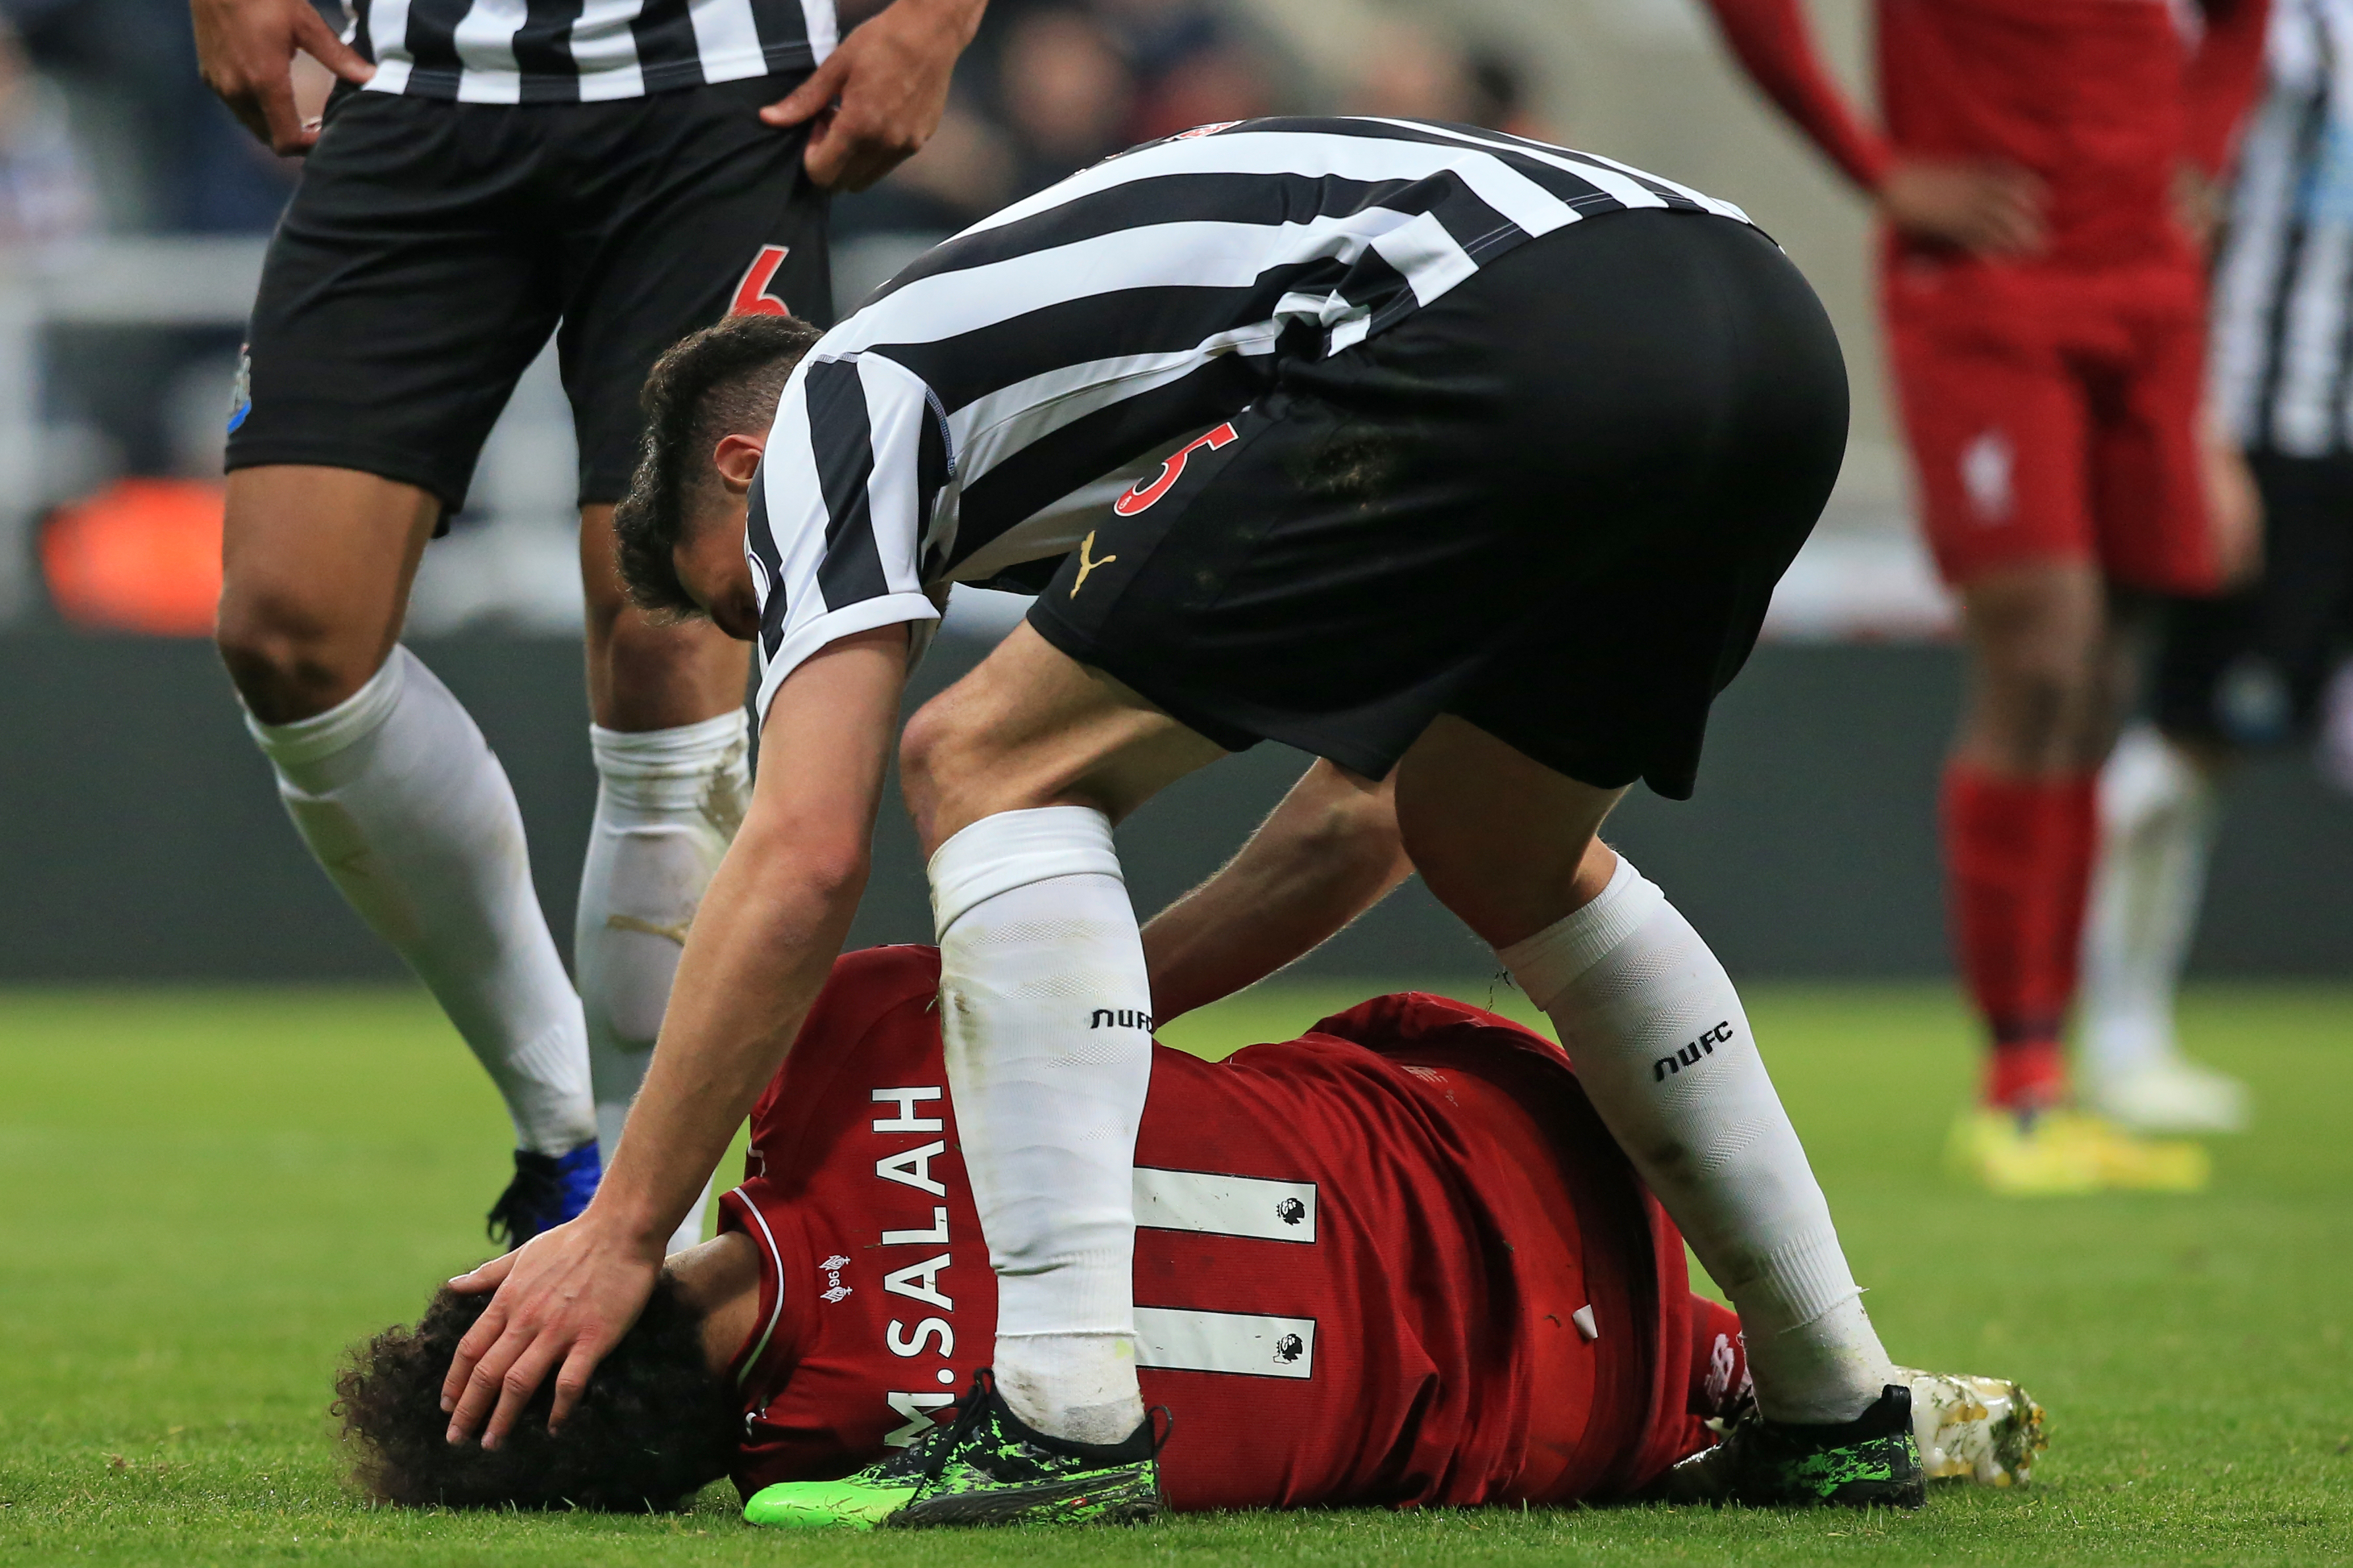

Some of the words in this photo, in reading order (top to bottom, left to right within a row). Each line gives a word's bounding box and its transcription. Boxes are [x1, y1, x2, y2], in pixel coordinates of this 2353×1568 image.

[1113, 421, 1239, 517] 5
[871, 1085, 956, 1447] M.SALAH
[1132, 1165, 1318, 1380] 11
